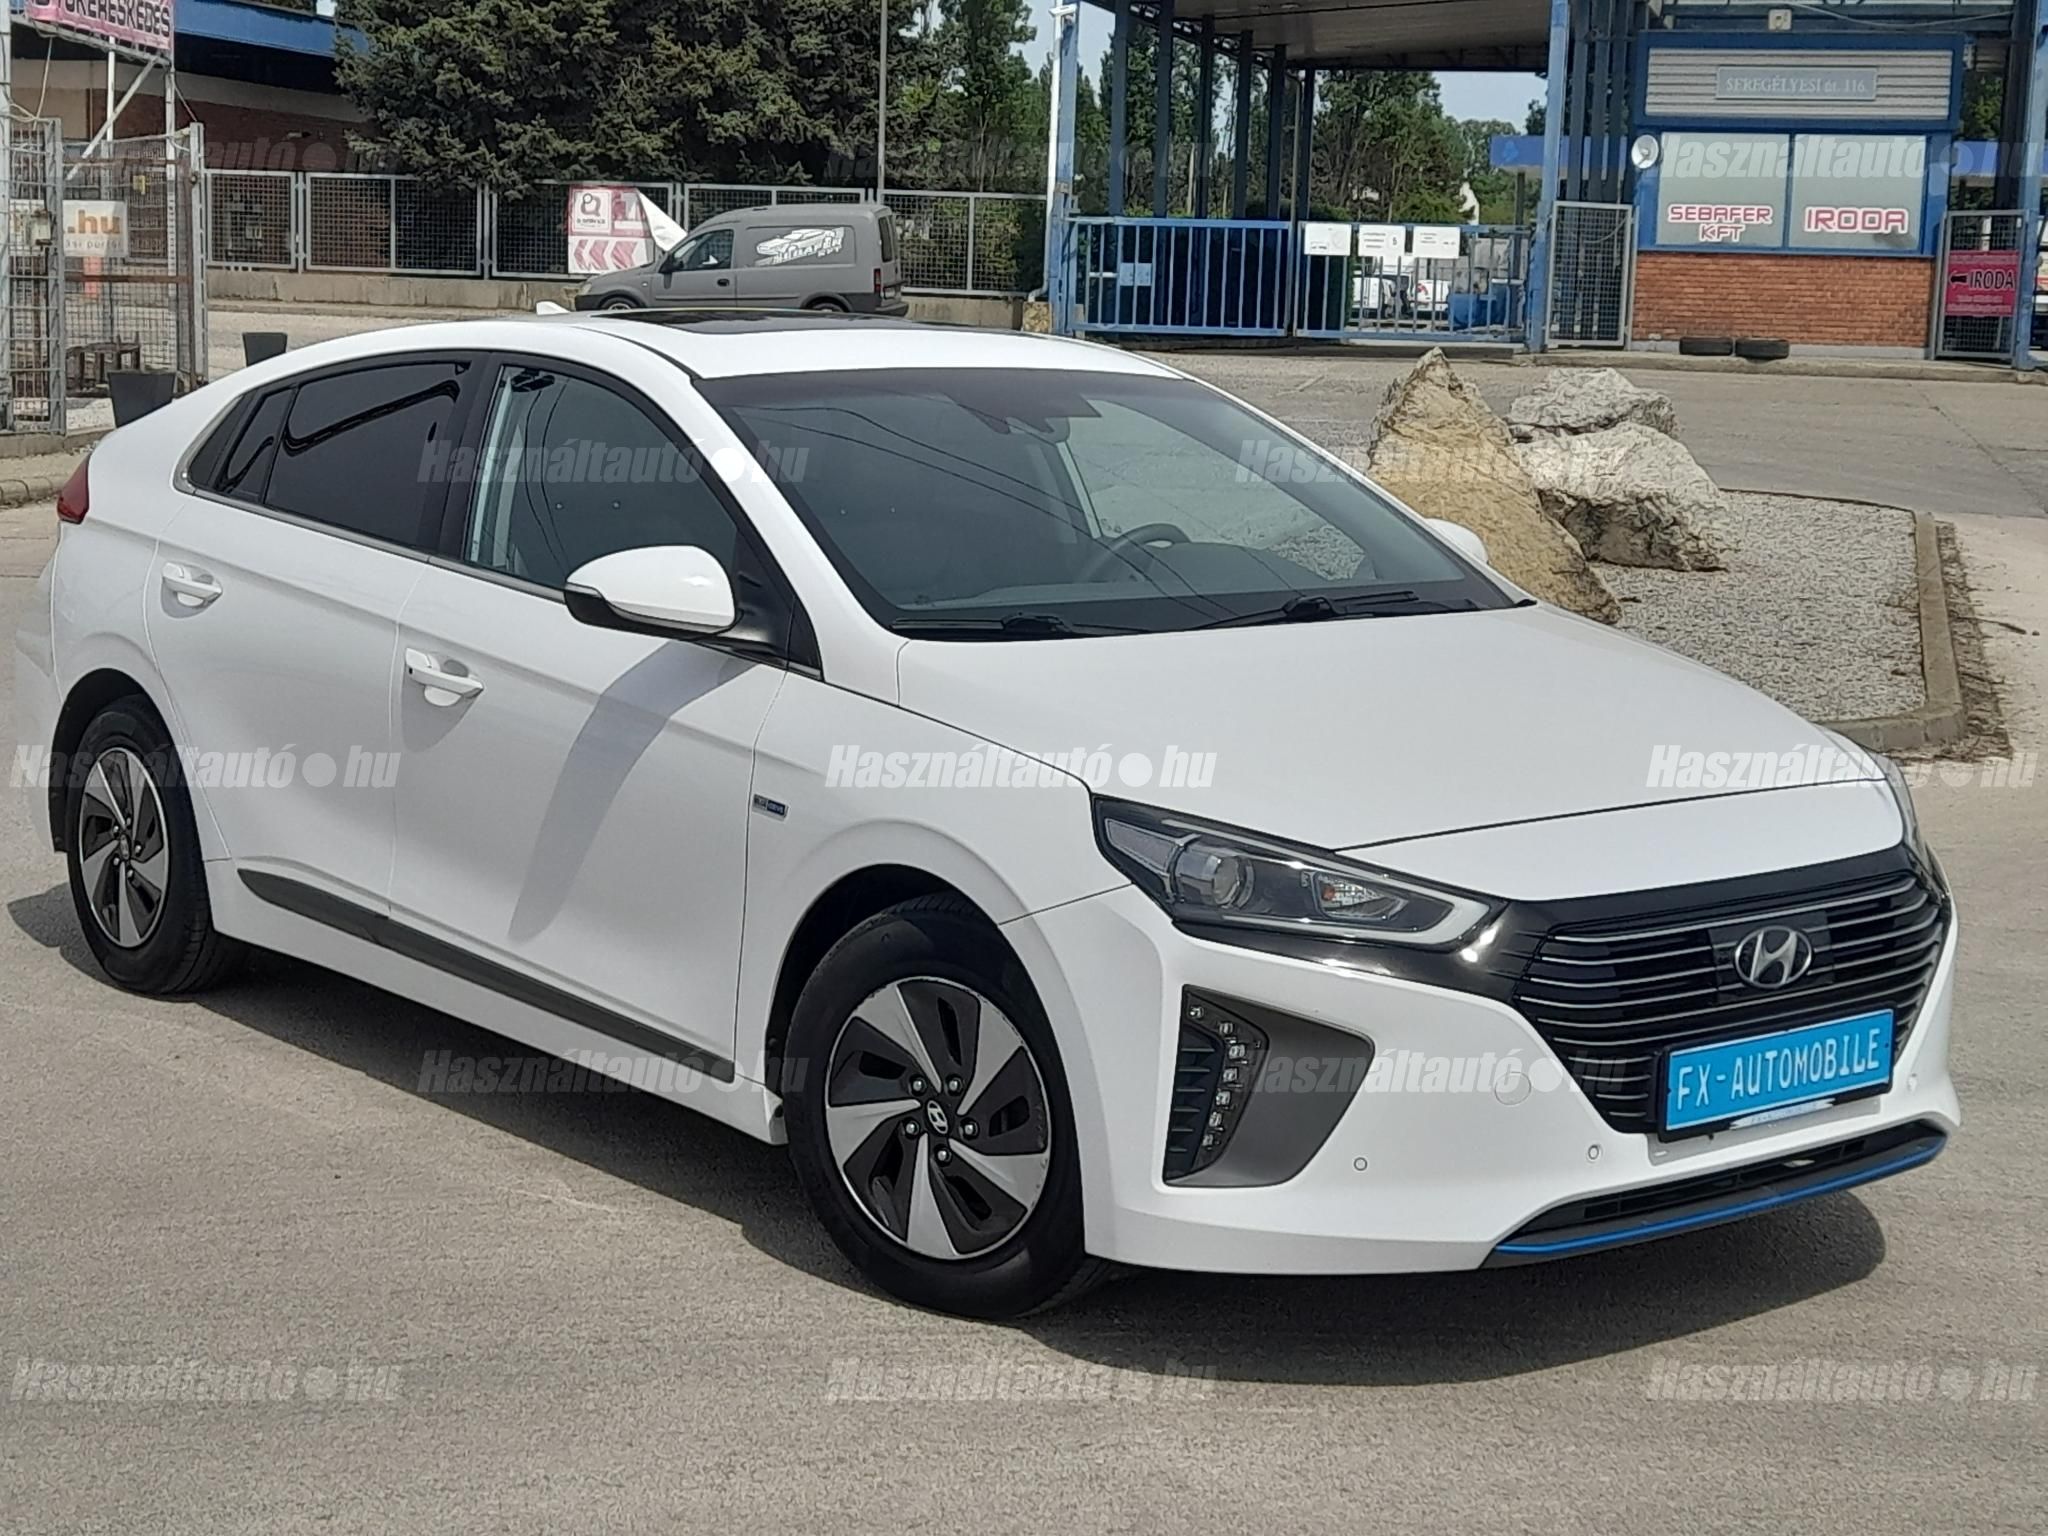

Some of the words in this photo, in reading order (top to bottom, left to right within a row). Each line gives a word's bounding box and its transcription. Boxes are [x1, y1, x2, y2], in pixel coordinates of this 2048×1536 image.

[1669, 205, 1772, 224] SEBAFER
[1806, 208, 1907, 232] IRODA
[1699, 225, 1744, 242] KFT
[1969, 270, 2015, 290] IRODA
[1677, 1028, 1881, 1110] FX-AUTOMOBILE
